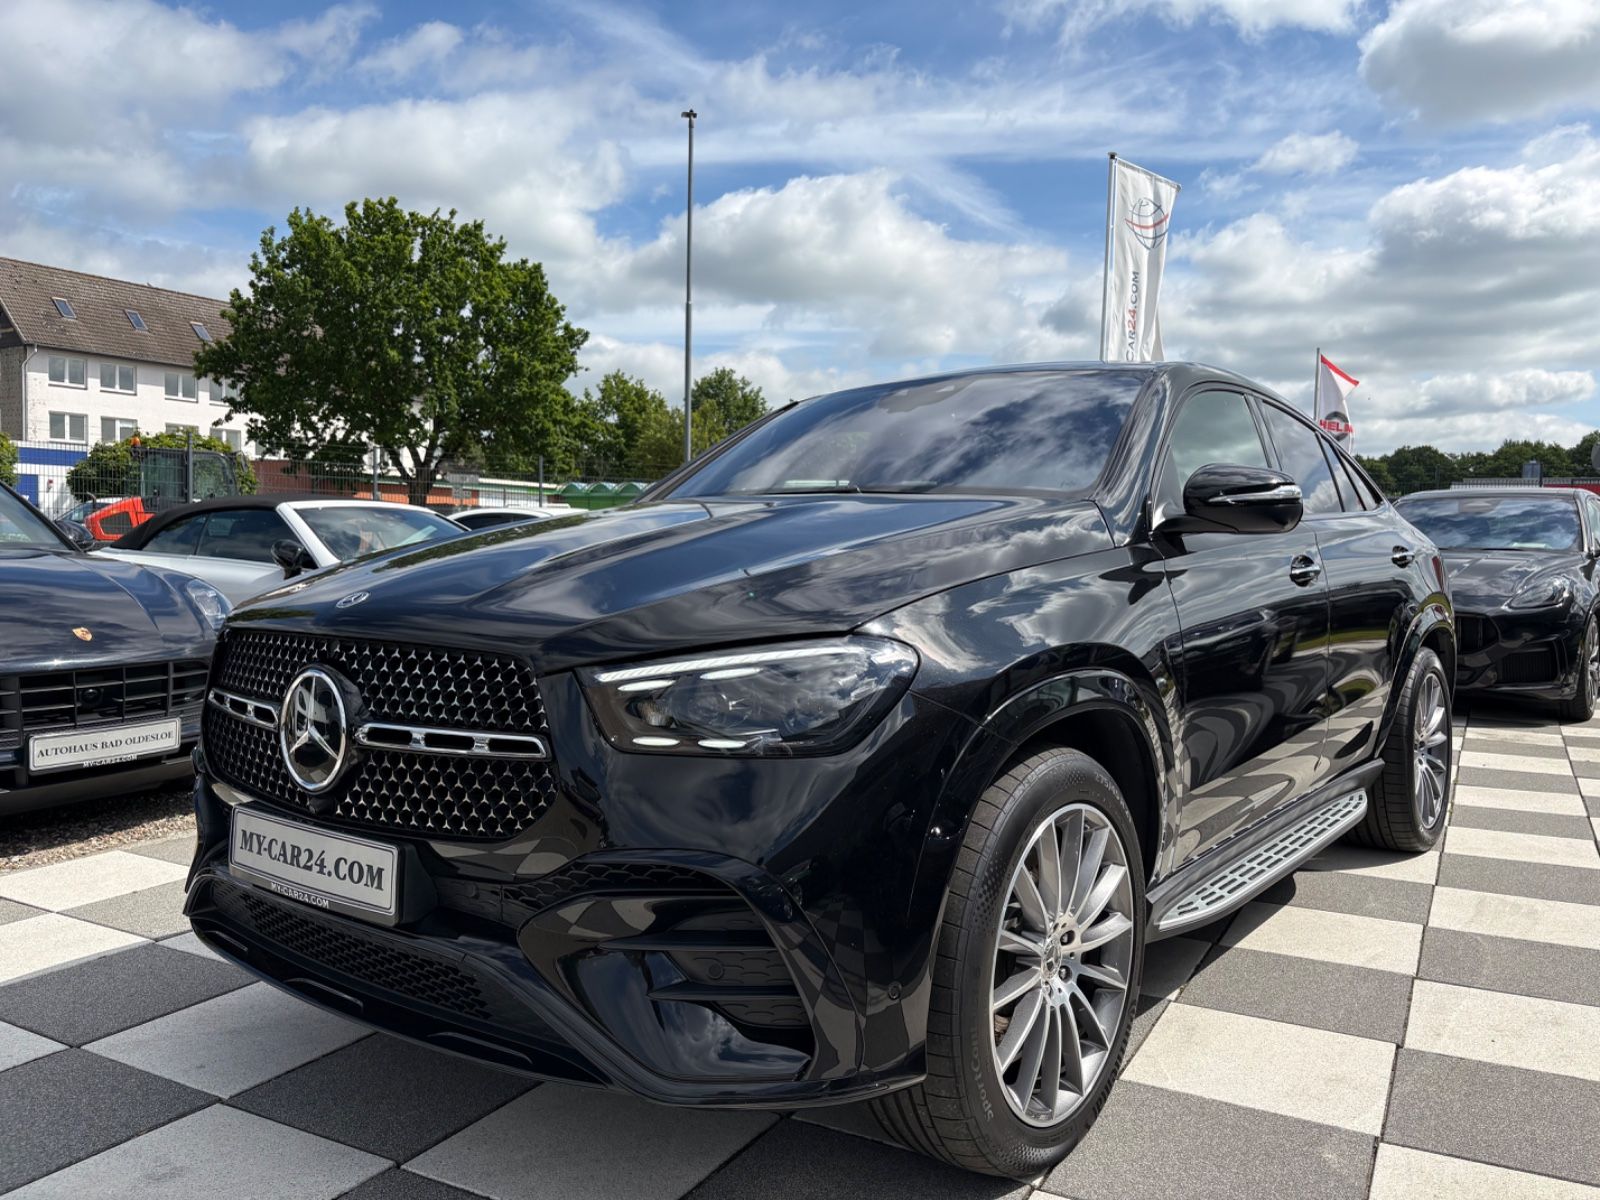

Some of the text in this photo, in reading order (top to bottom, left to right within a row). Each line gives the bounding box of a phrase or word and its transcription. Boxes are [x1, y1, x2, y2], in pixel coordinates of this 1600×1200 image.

[37, 730, 174, 758] AUTOHAUS BAD OLDESLOE
[239, 829, 385, 891] MY-CAR24.COM
[270, 881, 330, 909] MY-CAR24.COM
